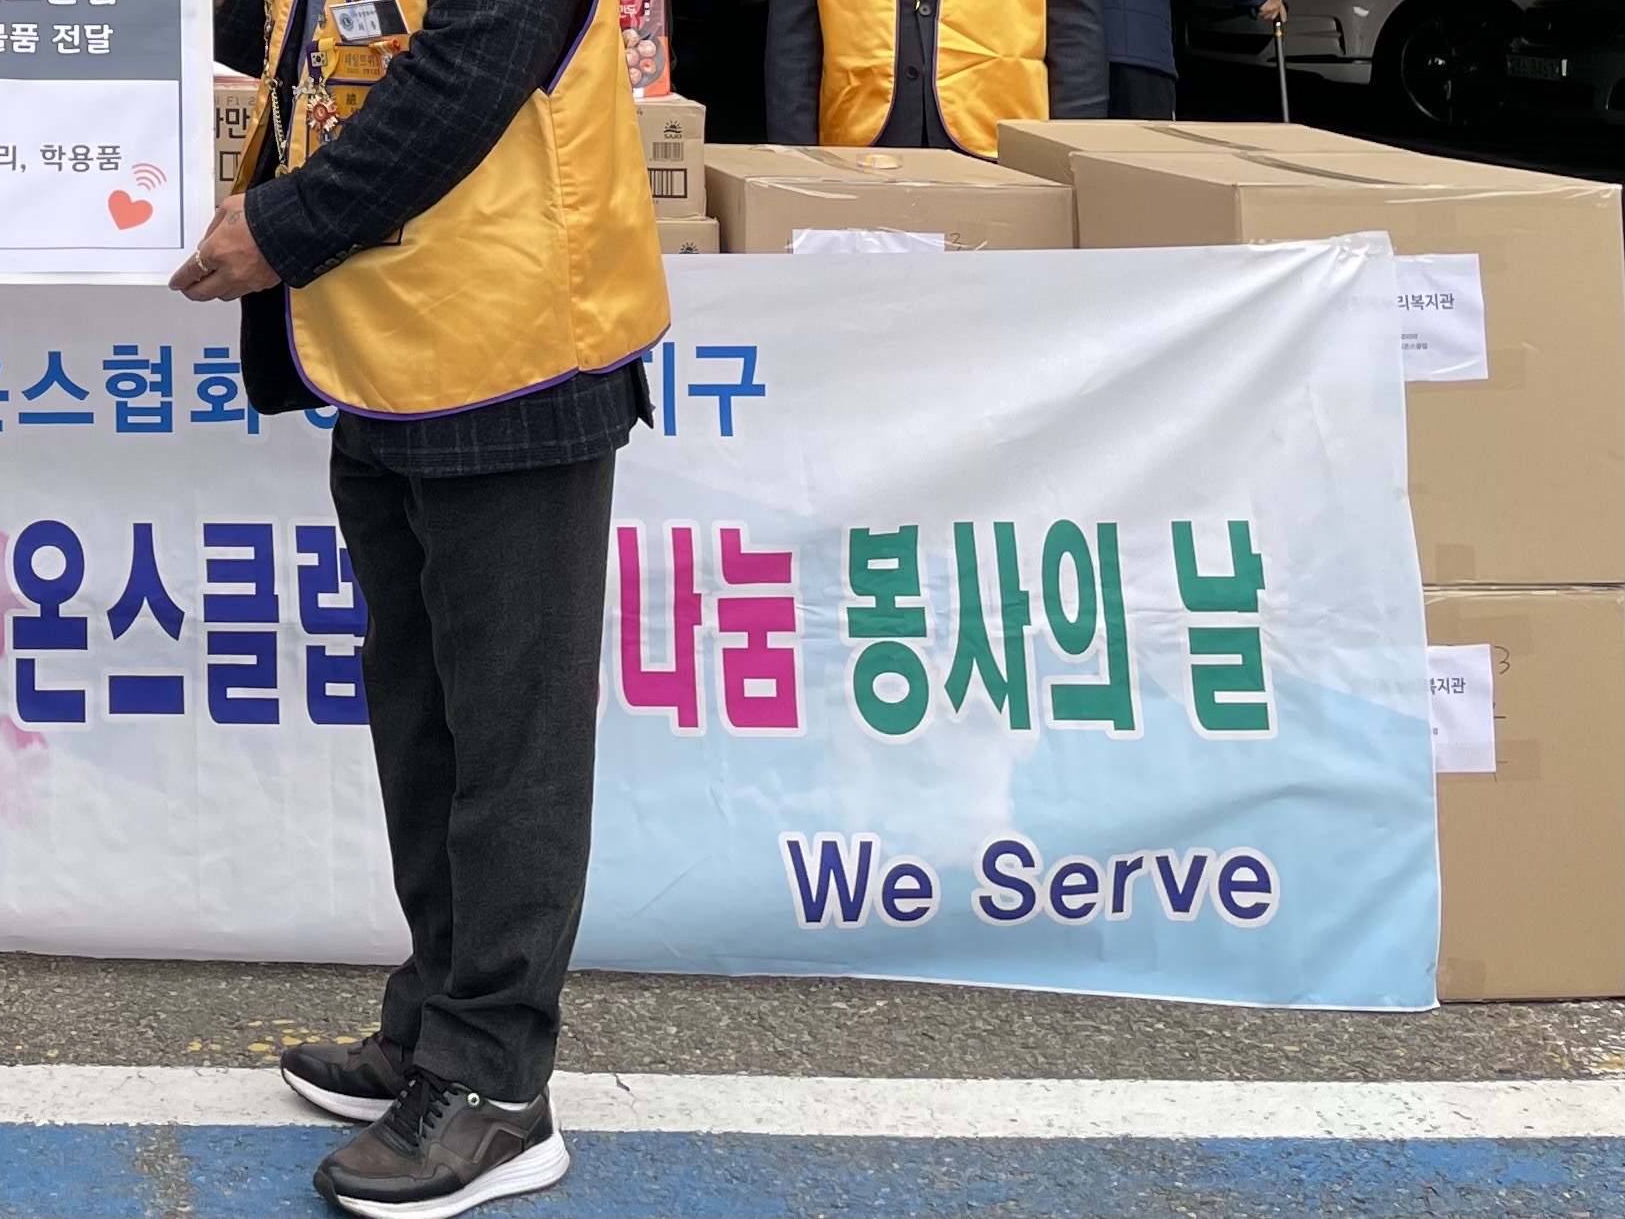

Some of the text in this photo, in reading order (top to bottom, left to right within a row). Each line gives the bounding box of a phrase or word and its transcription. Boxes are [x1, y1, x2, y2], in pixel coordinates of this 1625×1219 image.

[52, 22, 114, 56] 전달
[39, 143, 123, 173] 학용품
[616, 525, 799, 729] 나눔
[845, 518, 1135, 735] 봉사의
[1170, 519, 1274, 732] 날
[787, 838, 1274, 923] We Serve
